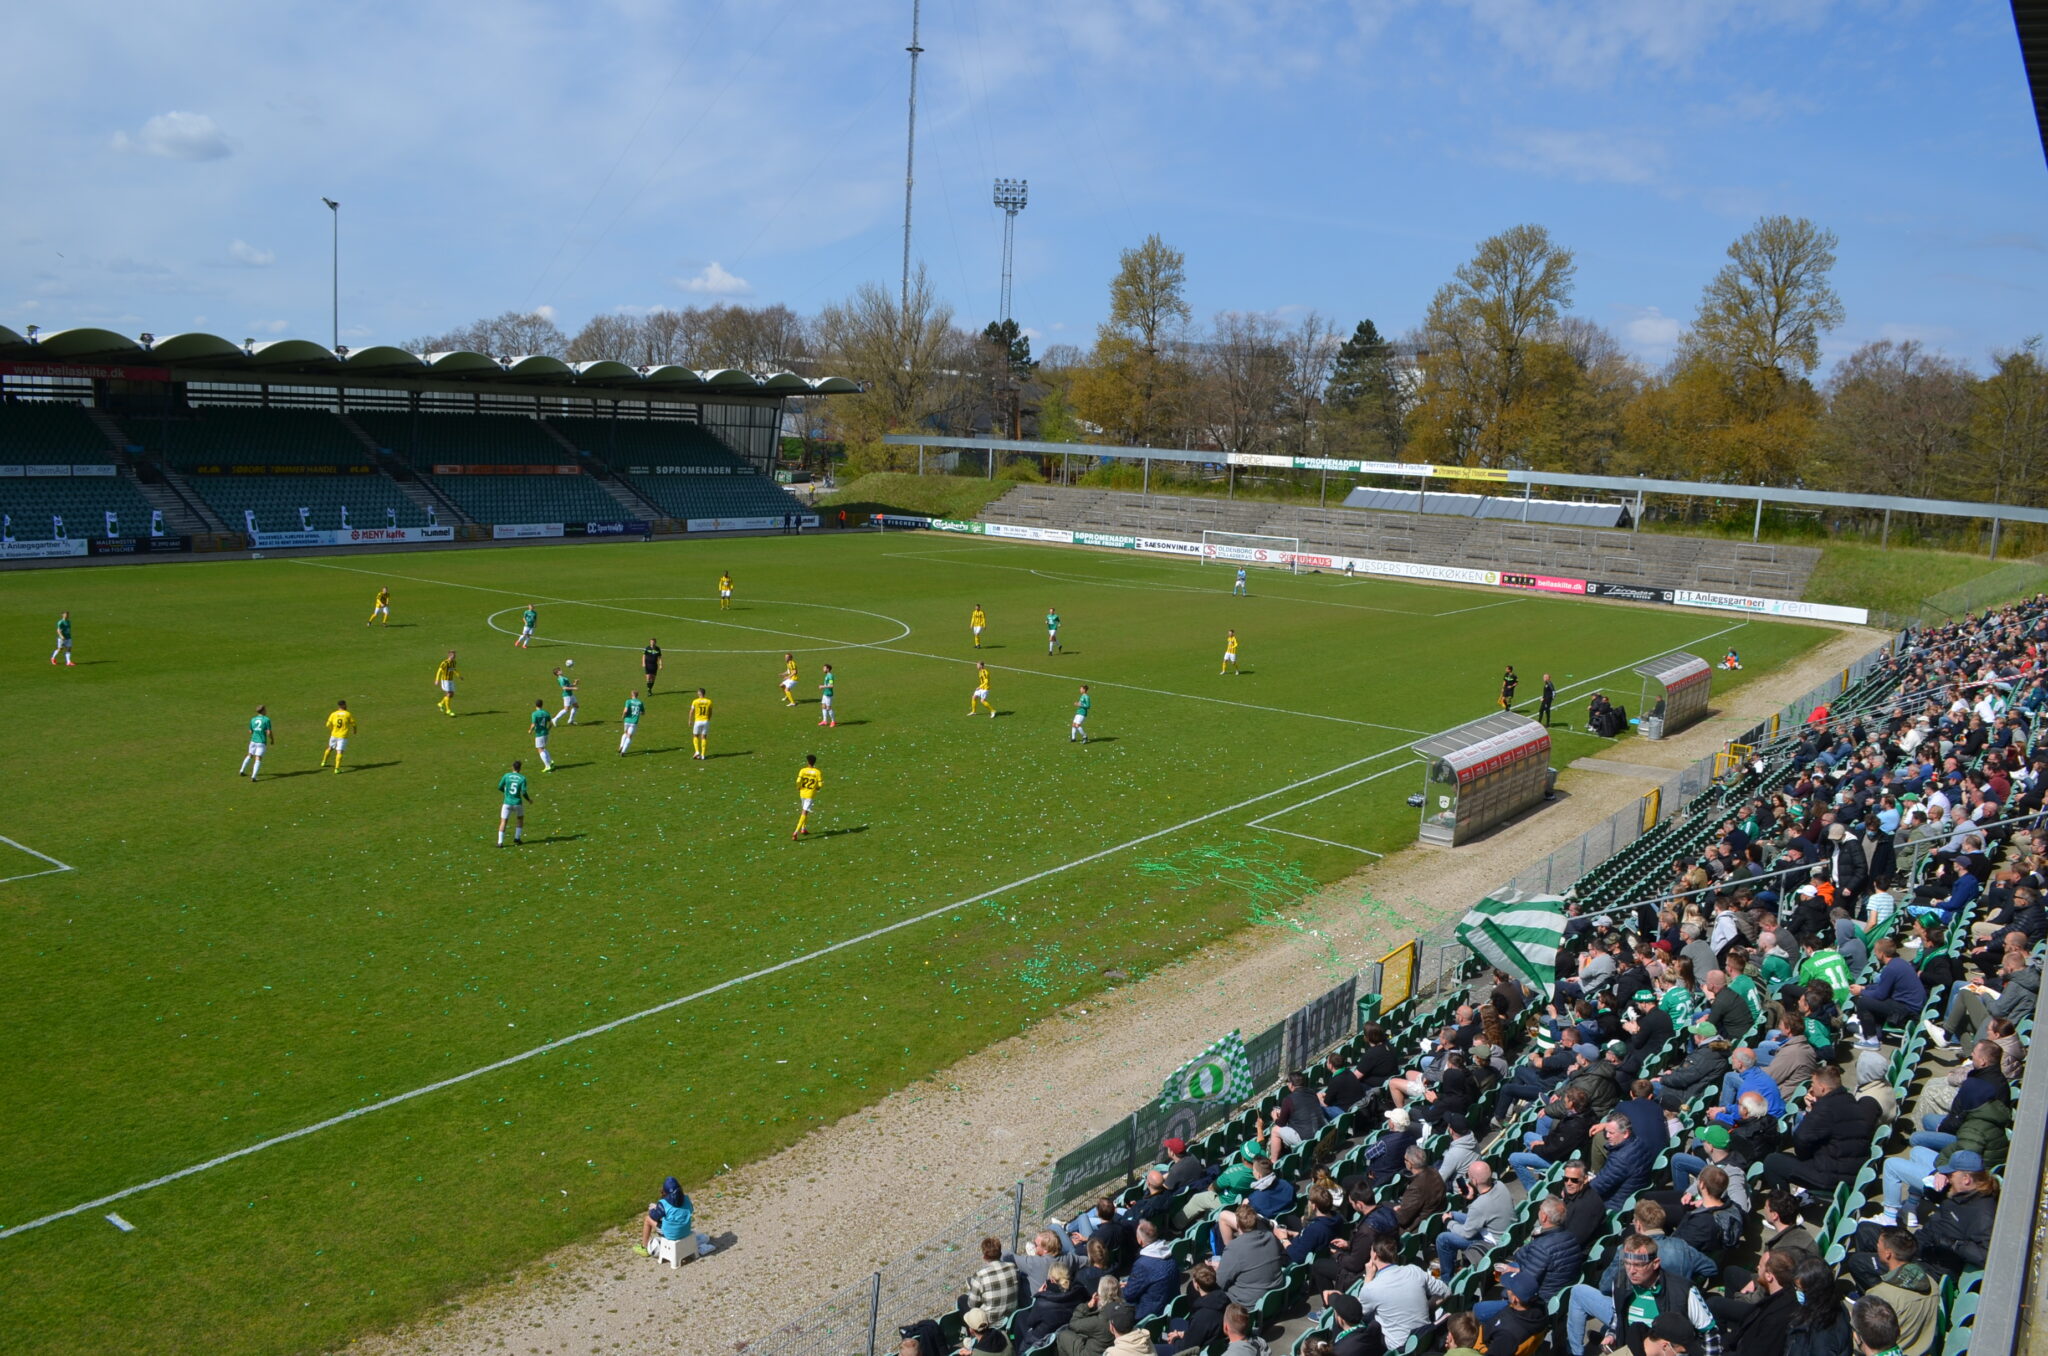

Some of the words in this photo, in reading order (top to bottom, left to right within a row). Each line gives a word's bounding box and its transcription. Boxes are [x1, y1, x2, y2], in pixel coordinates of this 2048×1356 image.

[13, 365, 125, 379] www.bellaskilte.dk
[1295, 457, 1361, 467] SØPROMENADEN
[655, 466, 732, 476] SØPROMENADEN
[932, 518, 969, 531] Carlsberg
[361, 530, 385, 540] MENY
[420, 528, 451, 537] hummel
[1074, 532, 1134, 544] SØPROMENADEN
[1218, 545, 1252, 554] OLDENBORG
[1359, 560, 1401, 573] JESPERS
[1405, 564, 1483, 582] TORVEKØKKEN
[1537, 579, 1583, 590] bellaskilte.dk
[699, 706, 707, 716] 11
[254, 719, 262, 731] 2
[336, 718, 343, 728] 9
[509, 783, 517, 795] 5
[802, 777, 814, 790] 22
[1825, 965, 1849, 989] 11
